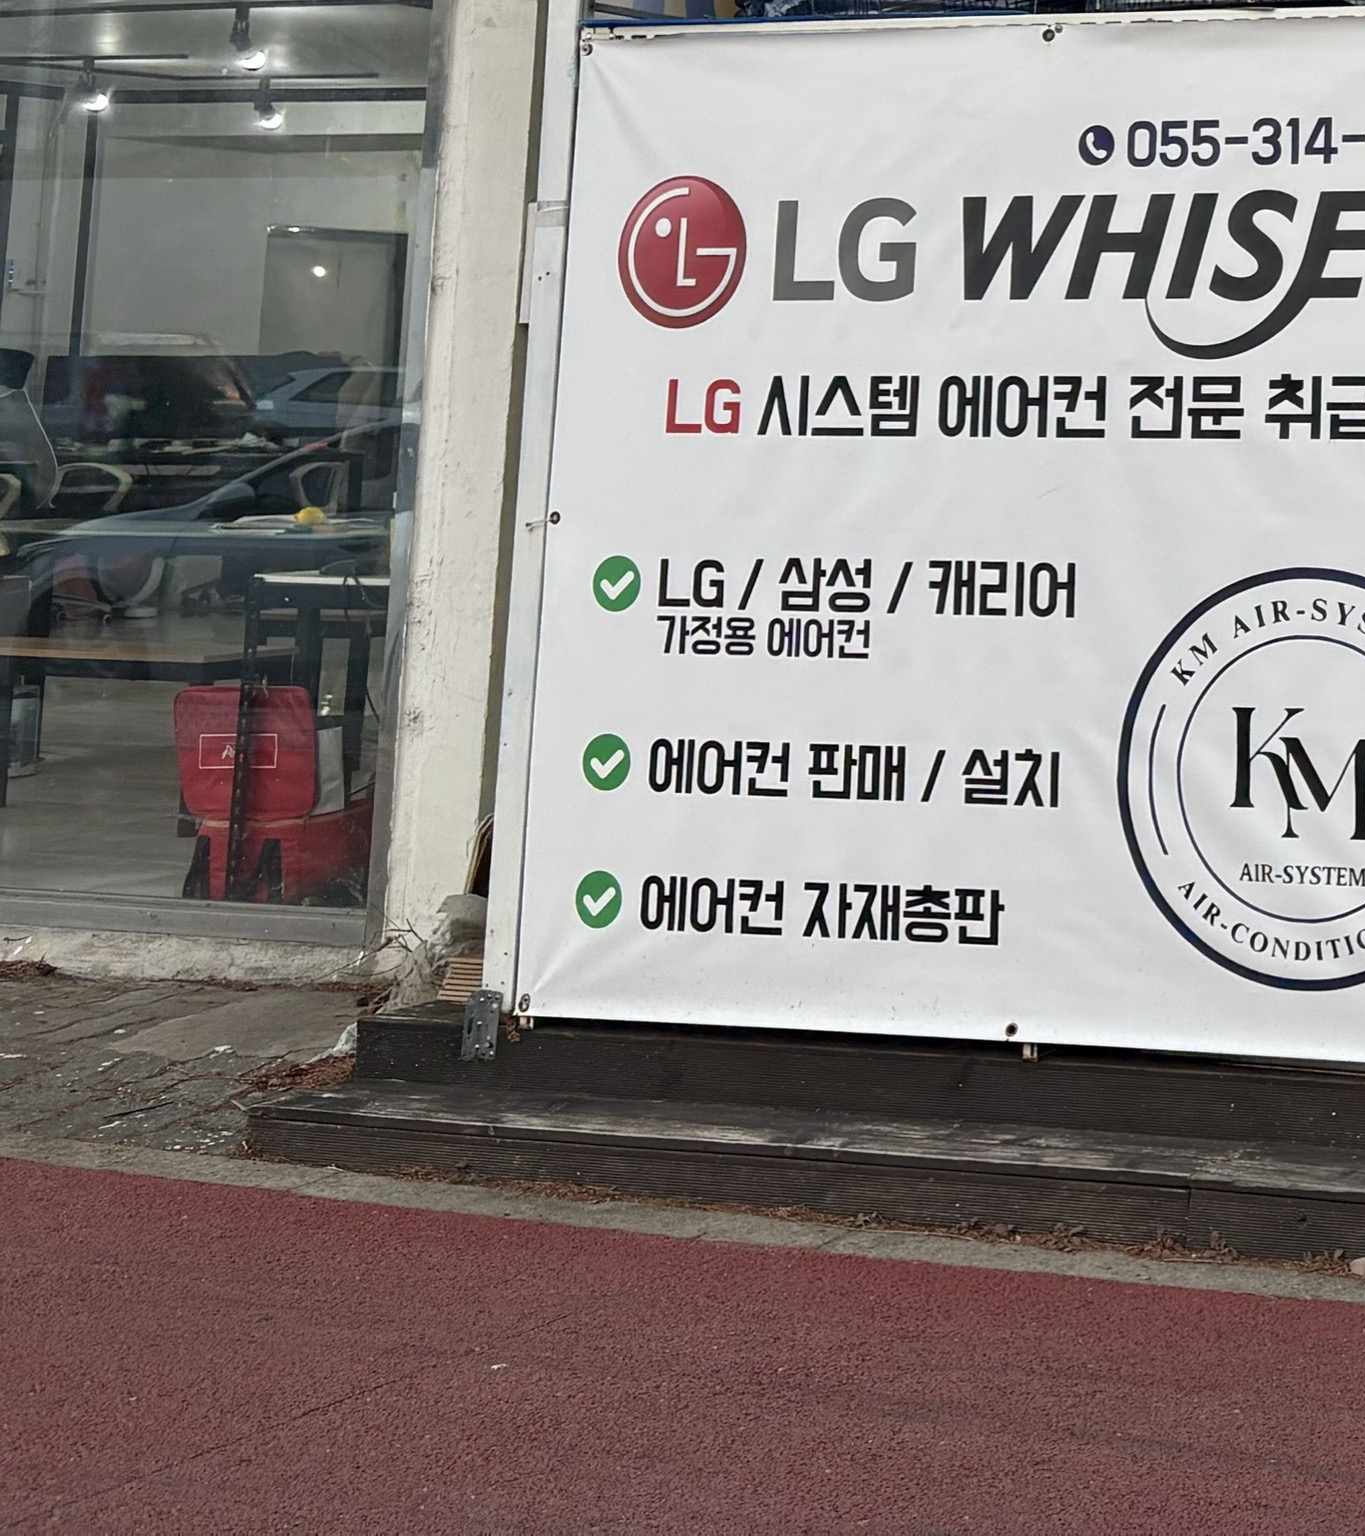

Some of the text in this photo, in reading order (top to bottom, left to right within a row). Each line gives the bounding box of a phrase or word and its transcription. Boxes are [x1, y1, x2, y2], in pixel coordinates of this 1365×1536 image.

[772, 197, 918, 302] LG
[665, 377, 742, 435] LG
[757, 373, 919, 439] 시스템
[938, 374, 1107, 440] 에어컨
[1128, 373, 1242, 442] 전문
[657, 558, 727, 611] LG
[777, 557, 874, 617] 삼성
[927, 558, 1077, 621] 캐리어
[658, 615, 872, 661] 가정용 에어컨
[1170, 629, 1216, 688] KM
[647, 737, 789, 799] 에어컨
[806, 740, 906, 804] 판매
[961, 747, 1061, 811] 설치
[639, 875, 1006, 947] 에어컨 자재총판
